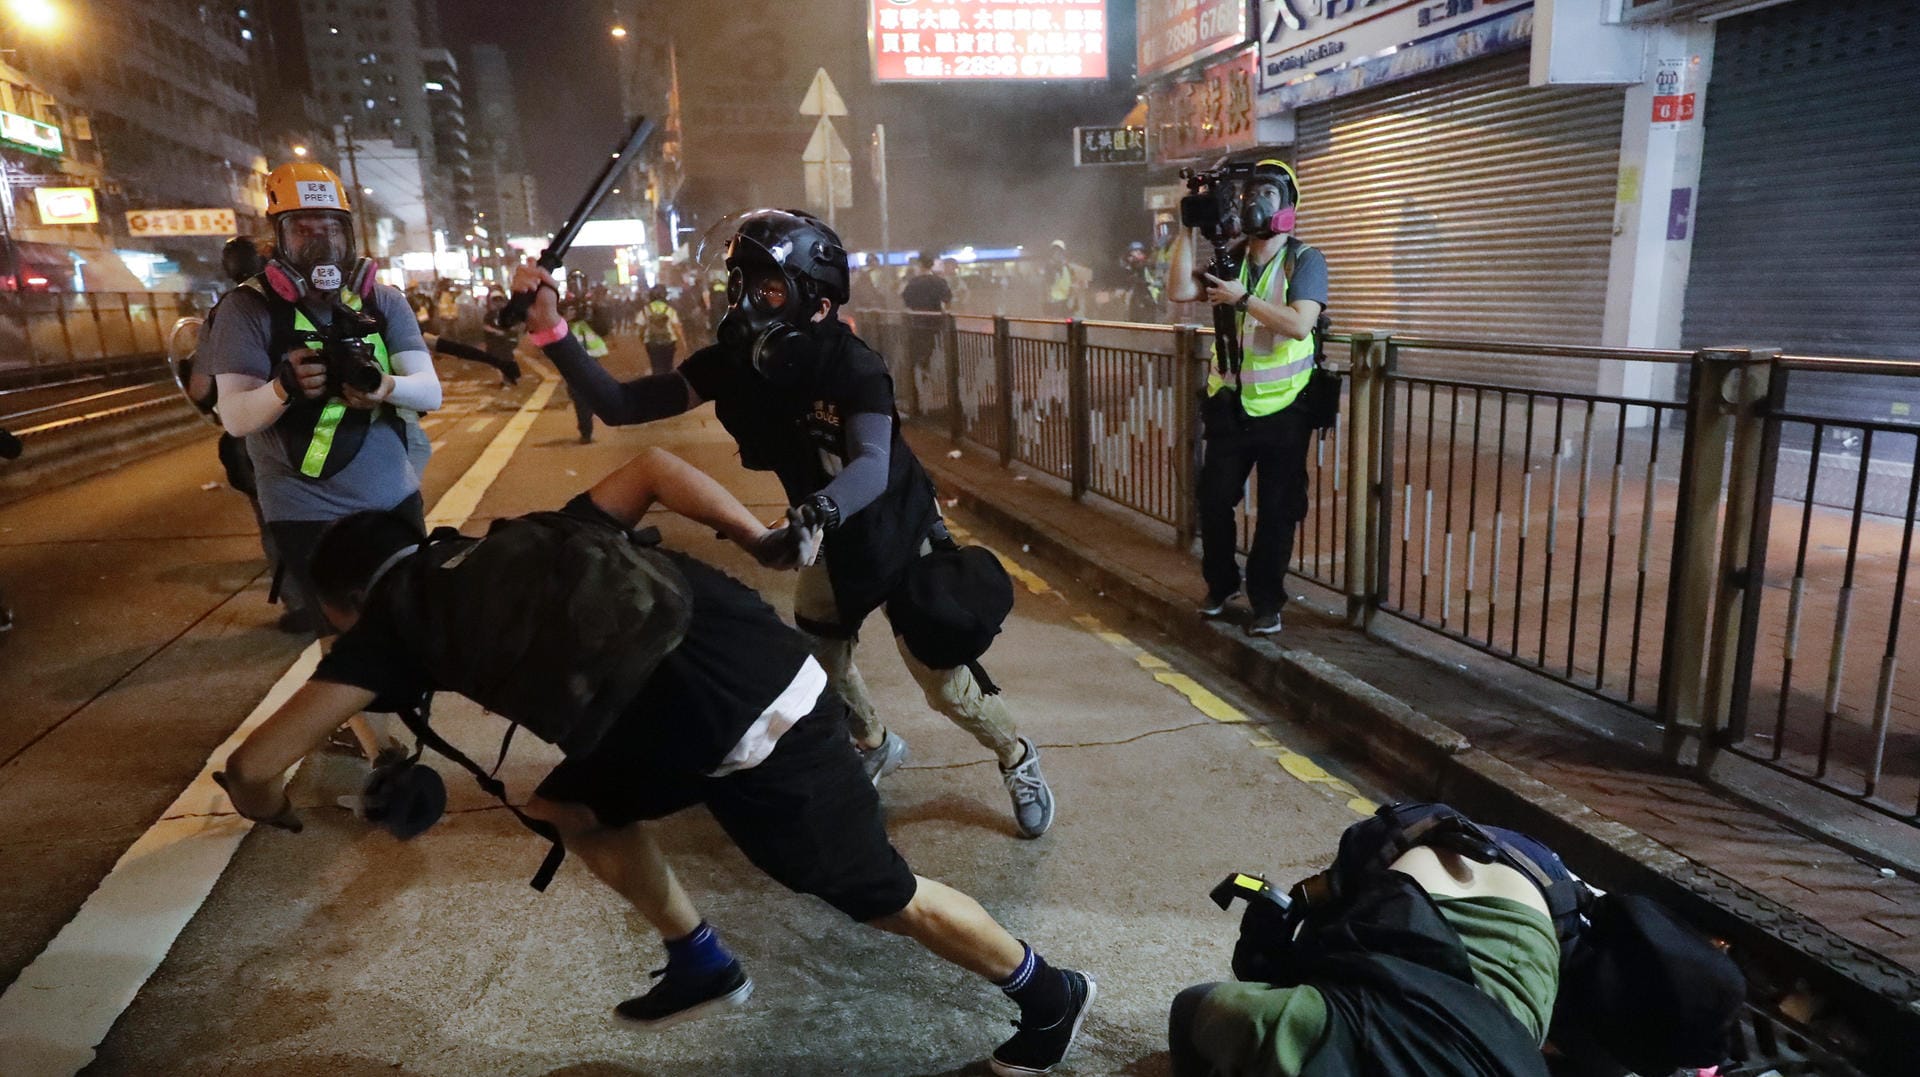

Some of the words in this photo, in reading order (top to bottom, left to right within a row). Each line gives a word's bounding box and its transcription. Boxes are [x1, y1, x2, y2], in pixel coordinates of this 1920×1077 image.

[1166, 17, 1197, 56] 2896
[308, 183, 327, 192] 記者
[304, 193, 335, 202] PRESS
[317, 268, 335, 277] 記者
[313, 278, 340, 287] PRESS
